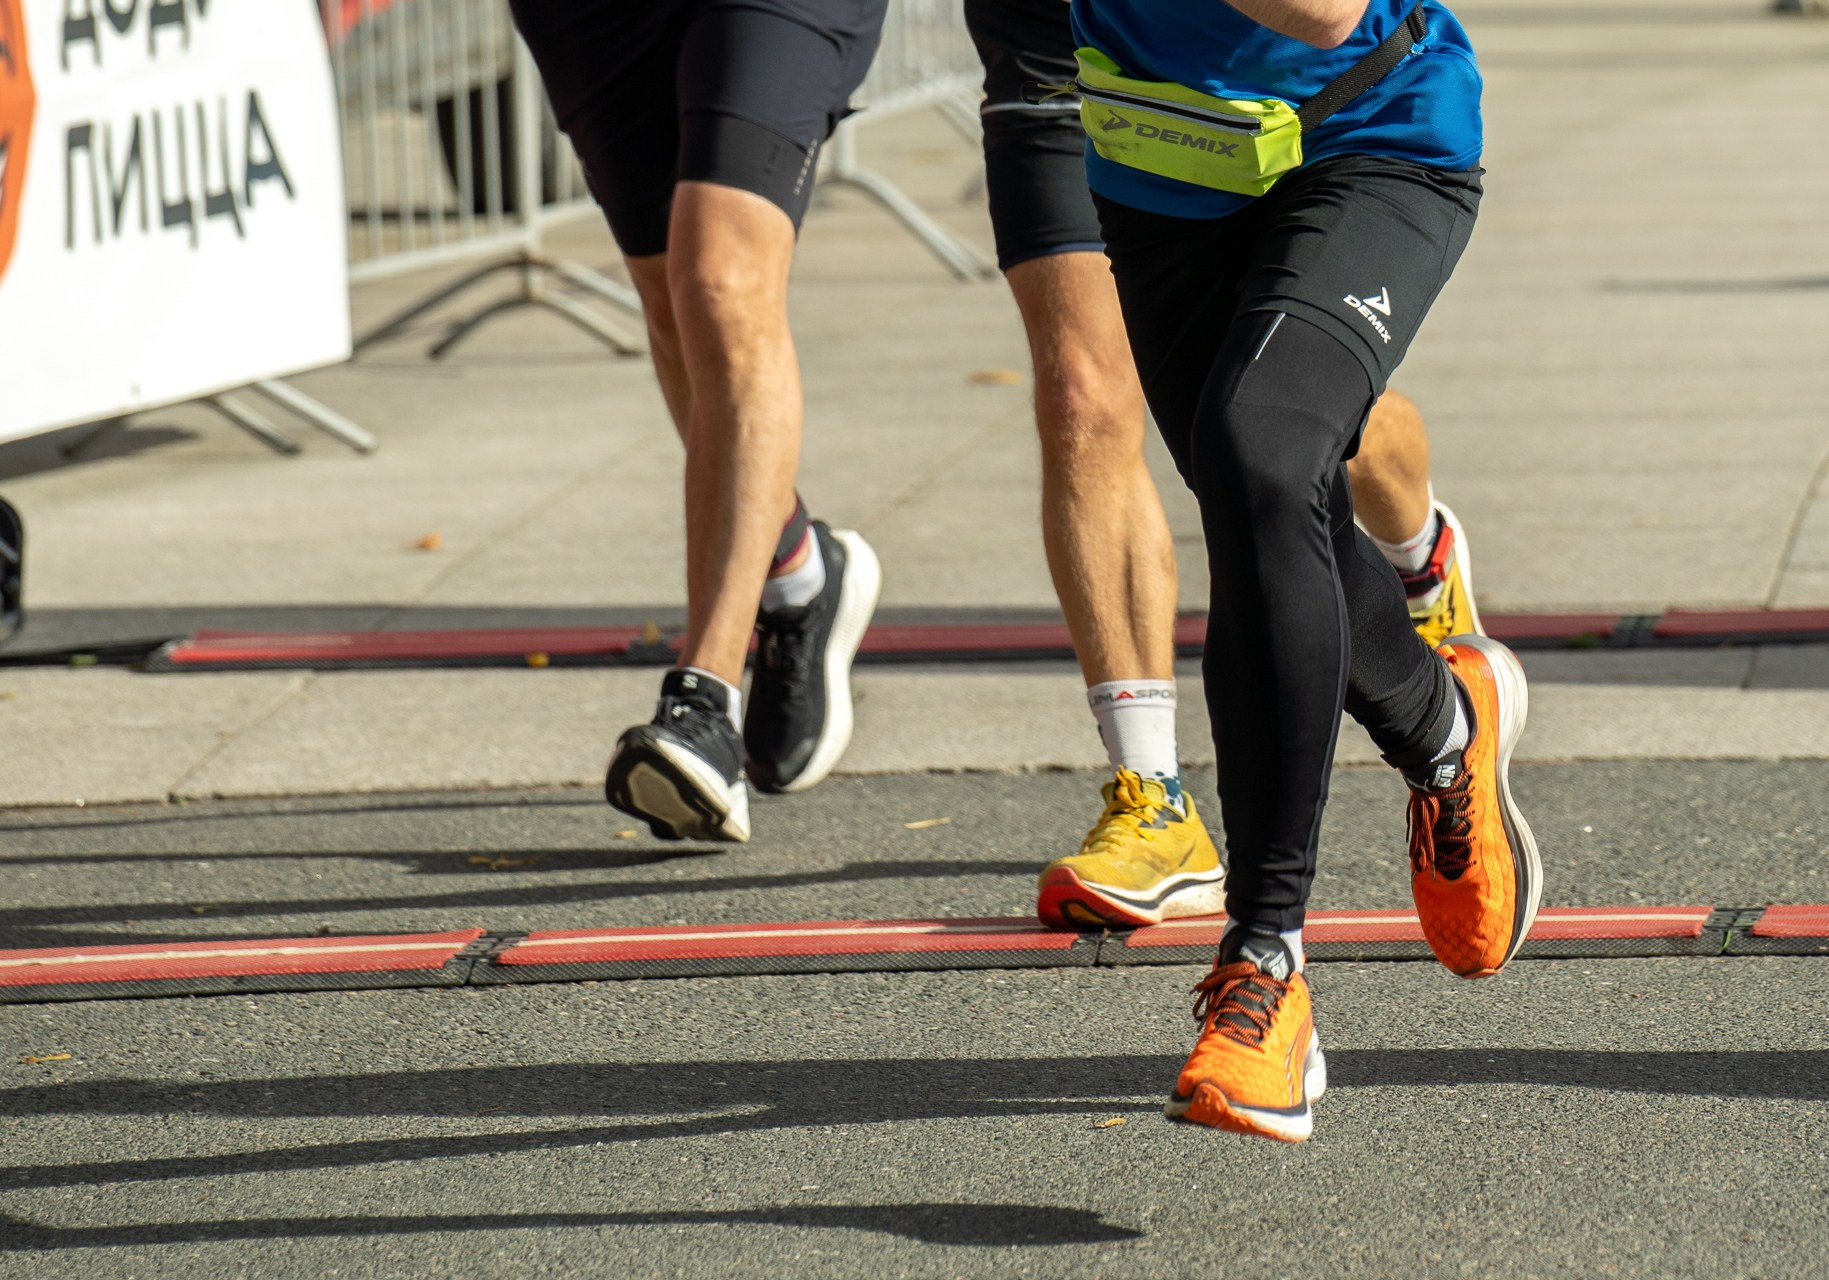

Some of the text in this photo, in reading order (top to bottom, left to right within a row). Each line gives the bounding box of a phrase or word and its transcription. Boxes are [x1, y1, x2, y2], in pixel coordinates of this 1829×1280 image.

[1134, 122, 1239, 158] DEMIX
[65, 87, 297, 252] ПИЦЦА
[1343, 294, 1391, 344] DEMIX
[1089, 689, 1176, 707] IMASPO
